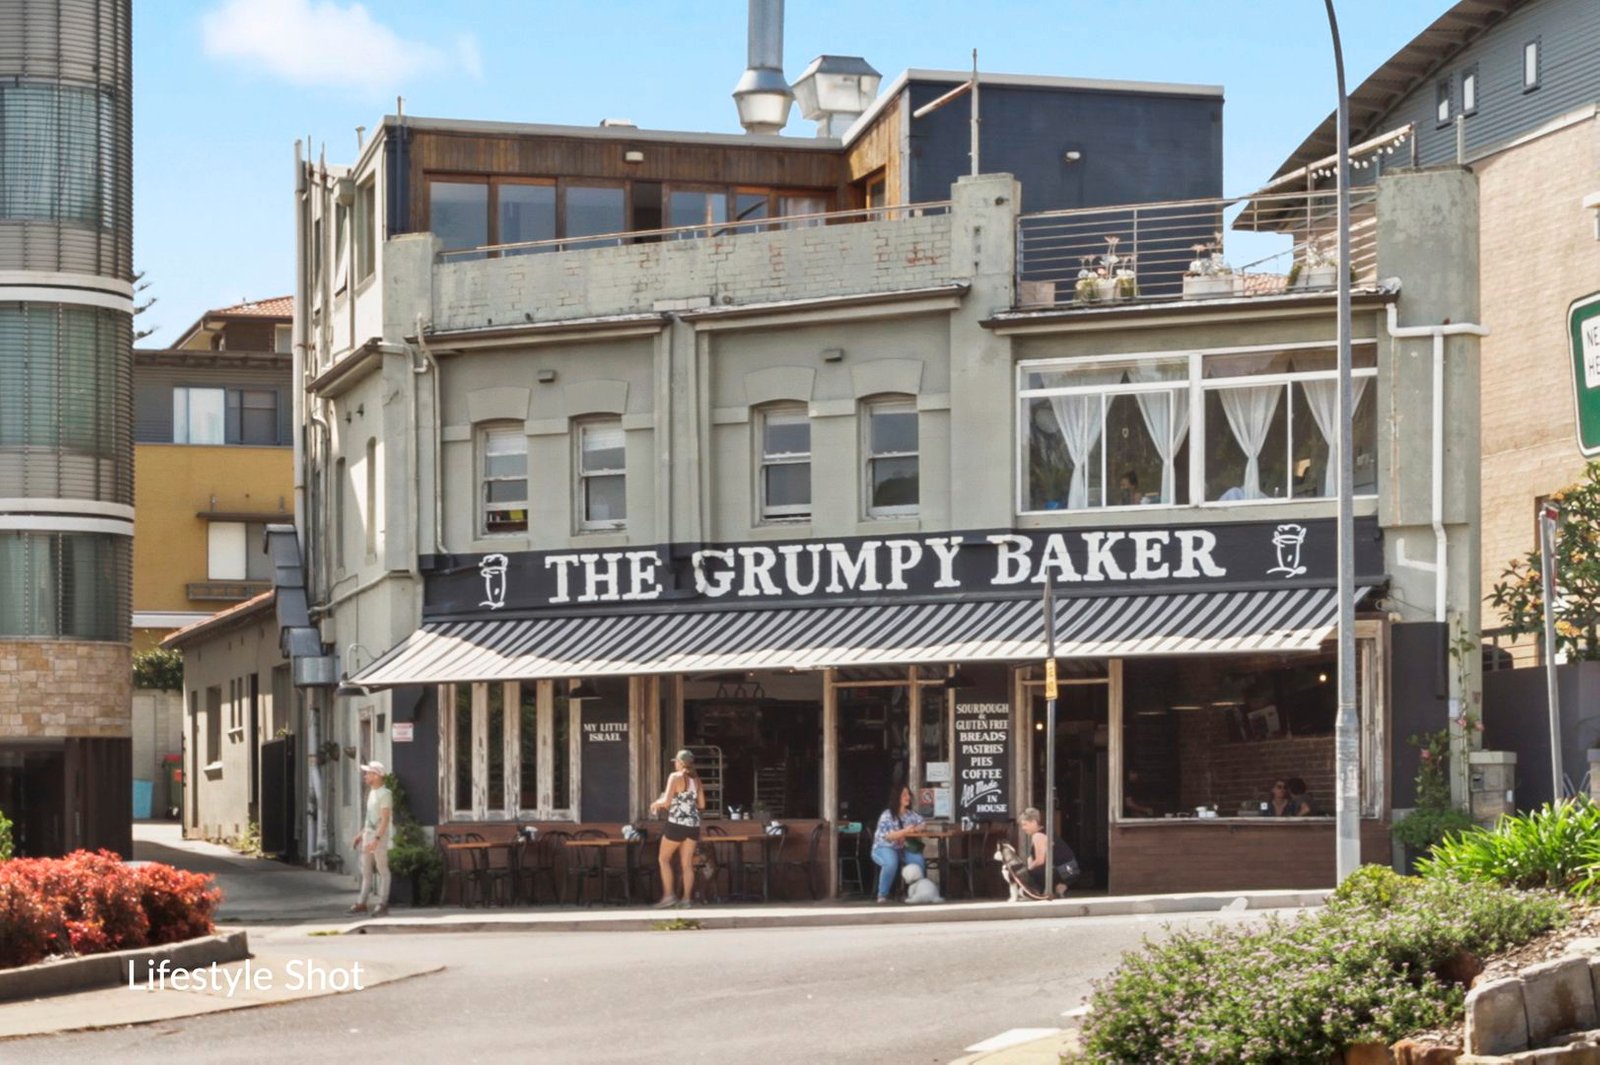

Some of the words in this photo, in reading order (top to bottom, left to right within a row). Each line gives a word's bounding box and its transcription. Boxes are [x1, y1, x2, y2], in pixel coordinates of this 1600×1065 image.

[544, 551, 663, 604] THE
[693, 537, 963, 598] GRUMPY
[986, 529, 1227, 585] BAKER
[956, 703, 1009, 714] SOURDOUGH
[583, 723, 597, 732] MY
[600, 723, 628, 732] LITTLE
[956, 720, 988, 730] GLUTEN
[989, 719, 1009, 729] FREE
[589, 733, 621, 742] ISRAEL
[959, 732, 1006, 742] BREADS
[962, 744, 1004, 754] PASTRIES
[971, 757, 993, 766] PIES
[962, 769, 1002, 779] COFFEE
[960, 784, 975, 806] All
[987, 795, 998, 803] IN
[976, 804, 1008, 813] HOUSE
